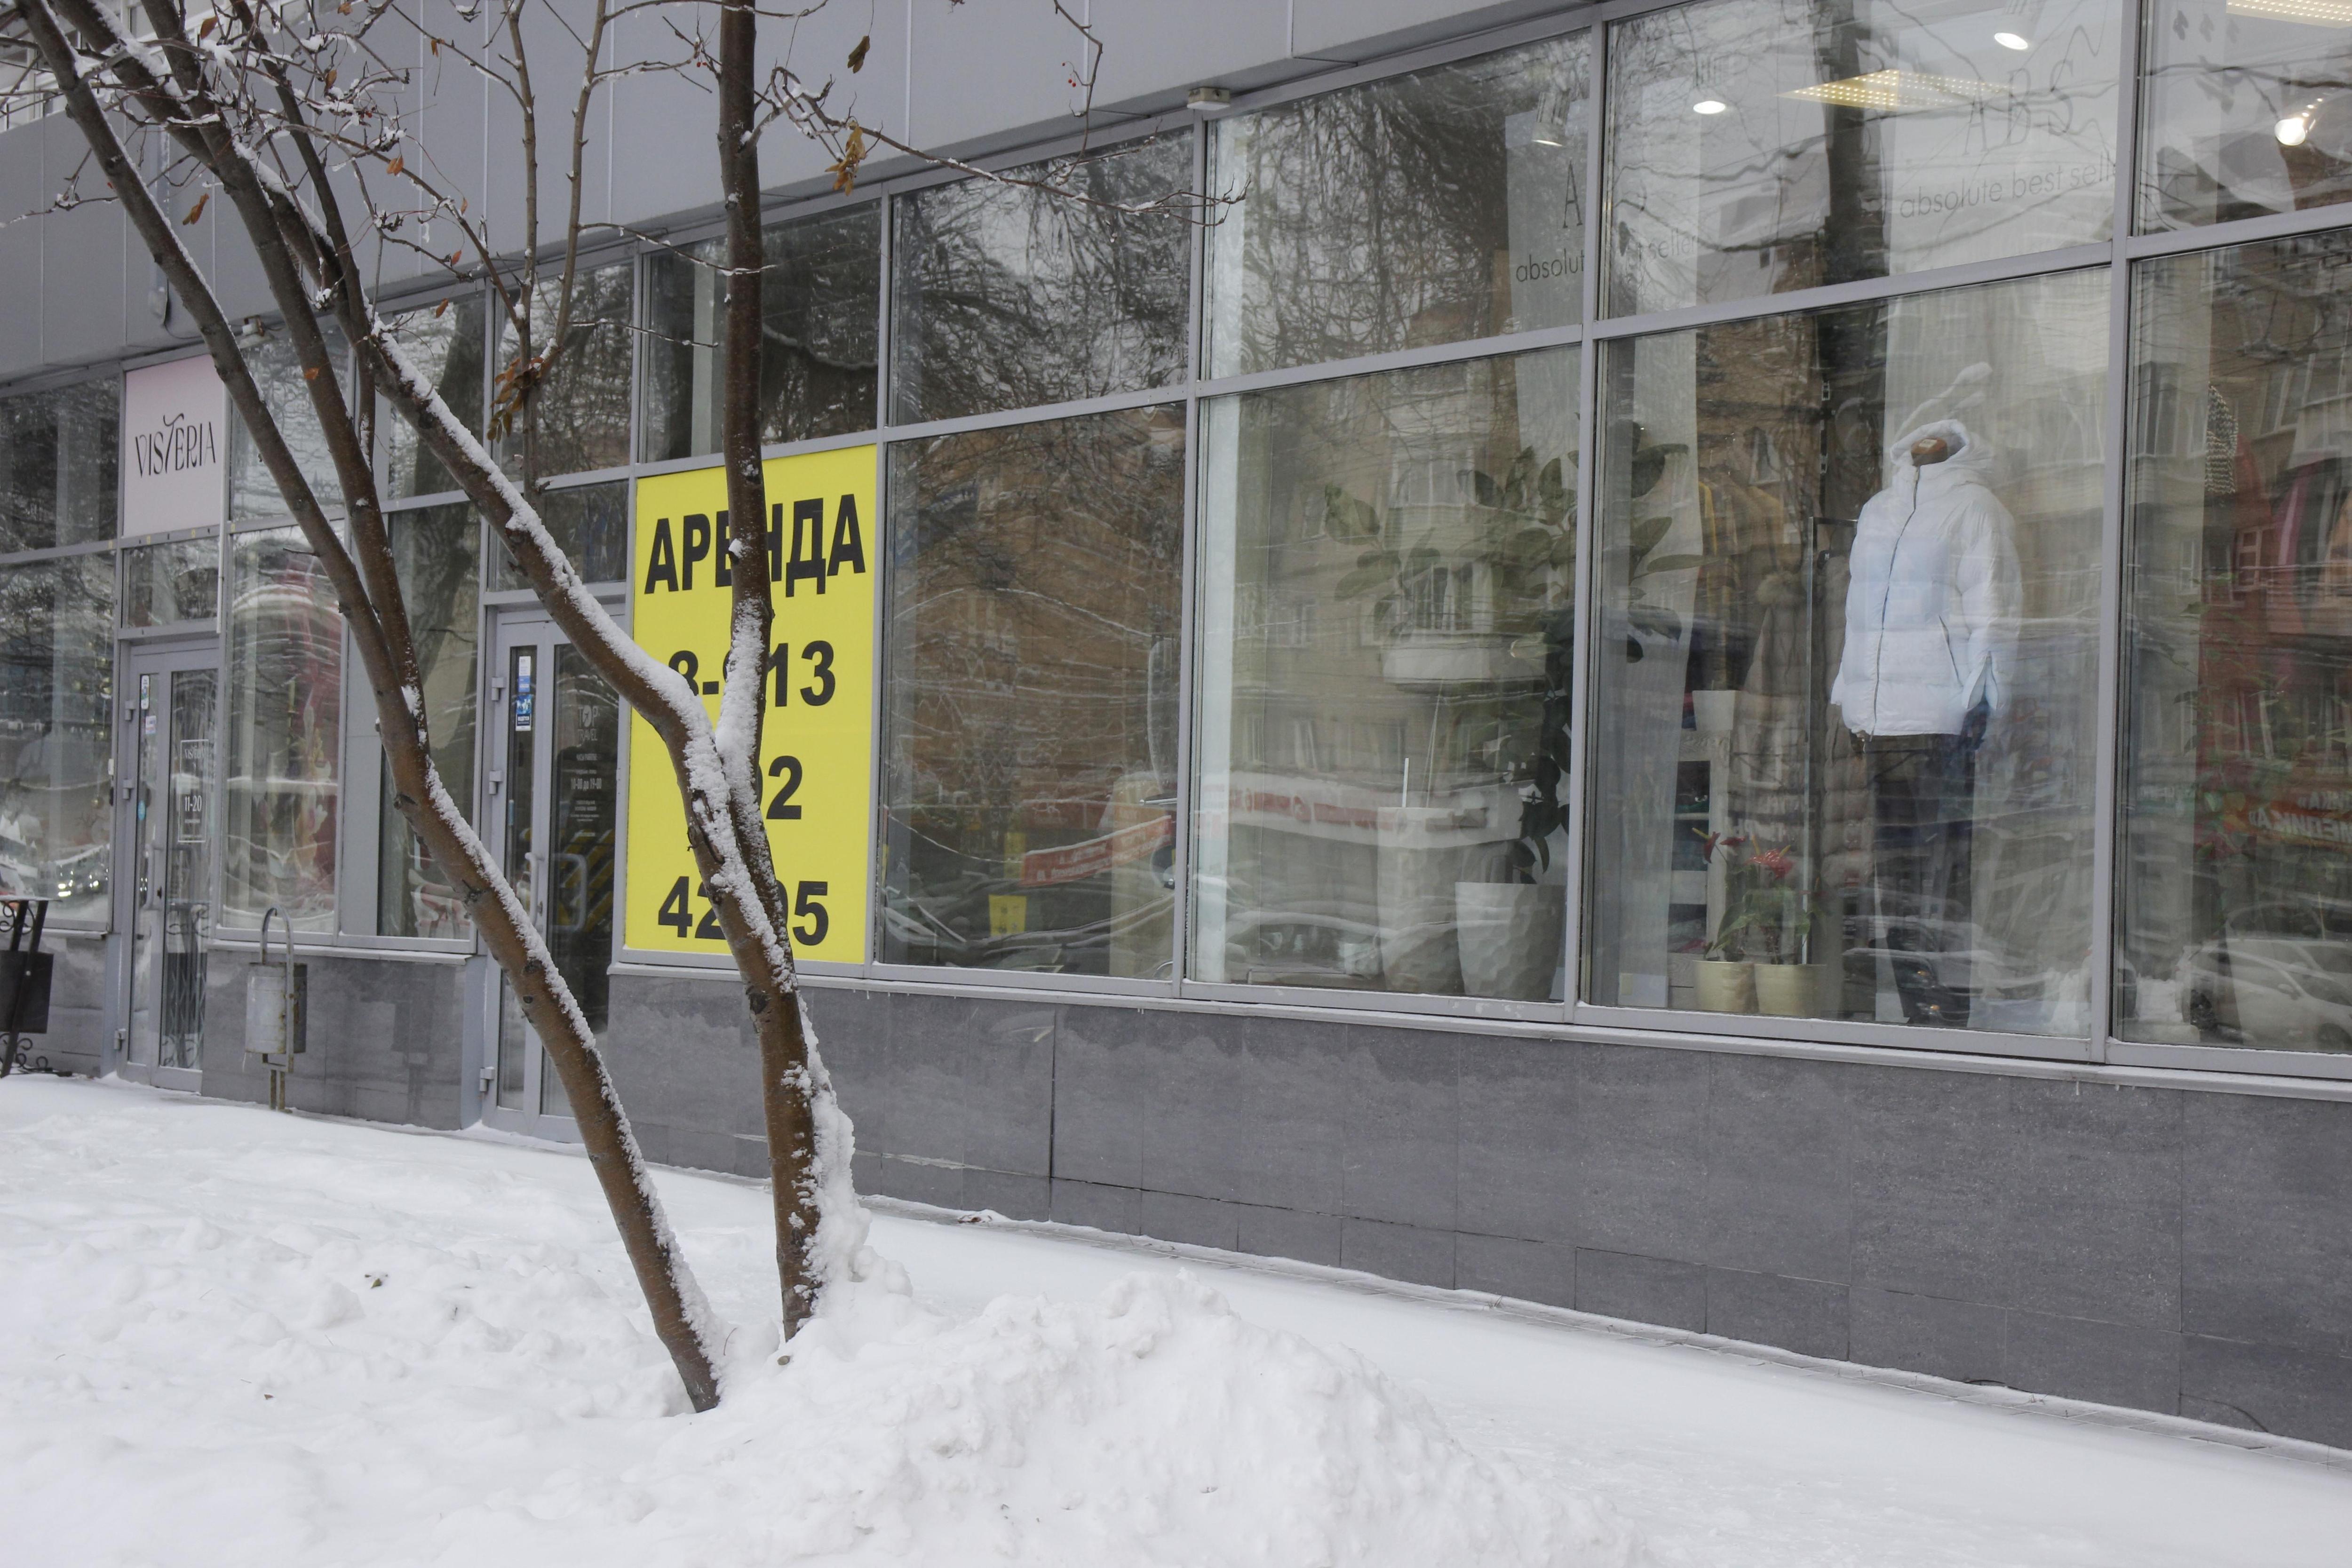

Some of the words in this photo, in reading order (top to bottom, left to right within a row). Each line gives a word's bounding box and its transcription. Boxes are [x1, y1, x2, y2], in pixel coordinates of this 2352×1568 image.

[1900, 178, 2002, 218] absolute
[2012, 166, 2063, 199] best
[135, 413, 215, 478] VISTERIA
[668, 640, 835, 707] 8-13
[185, 795, 202, 812] 11-20
